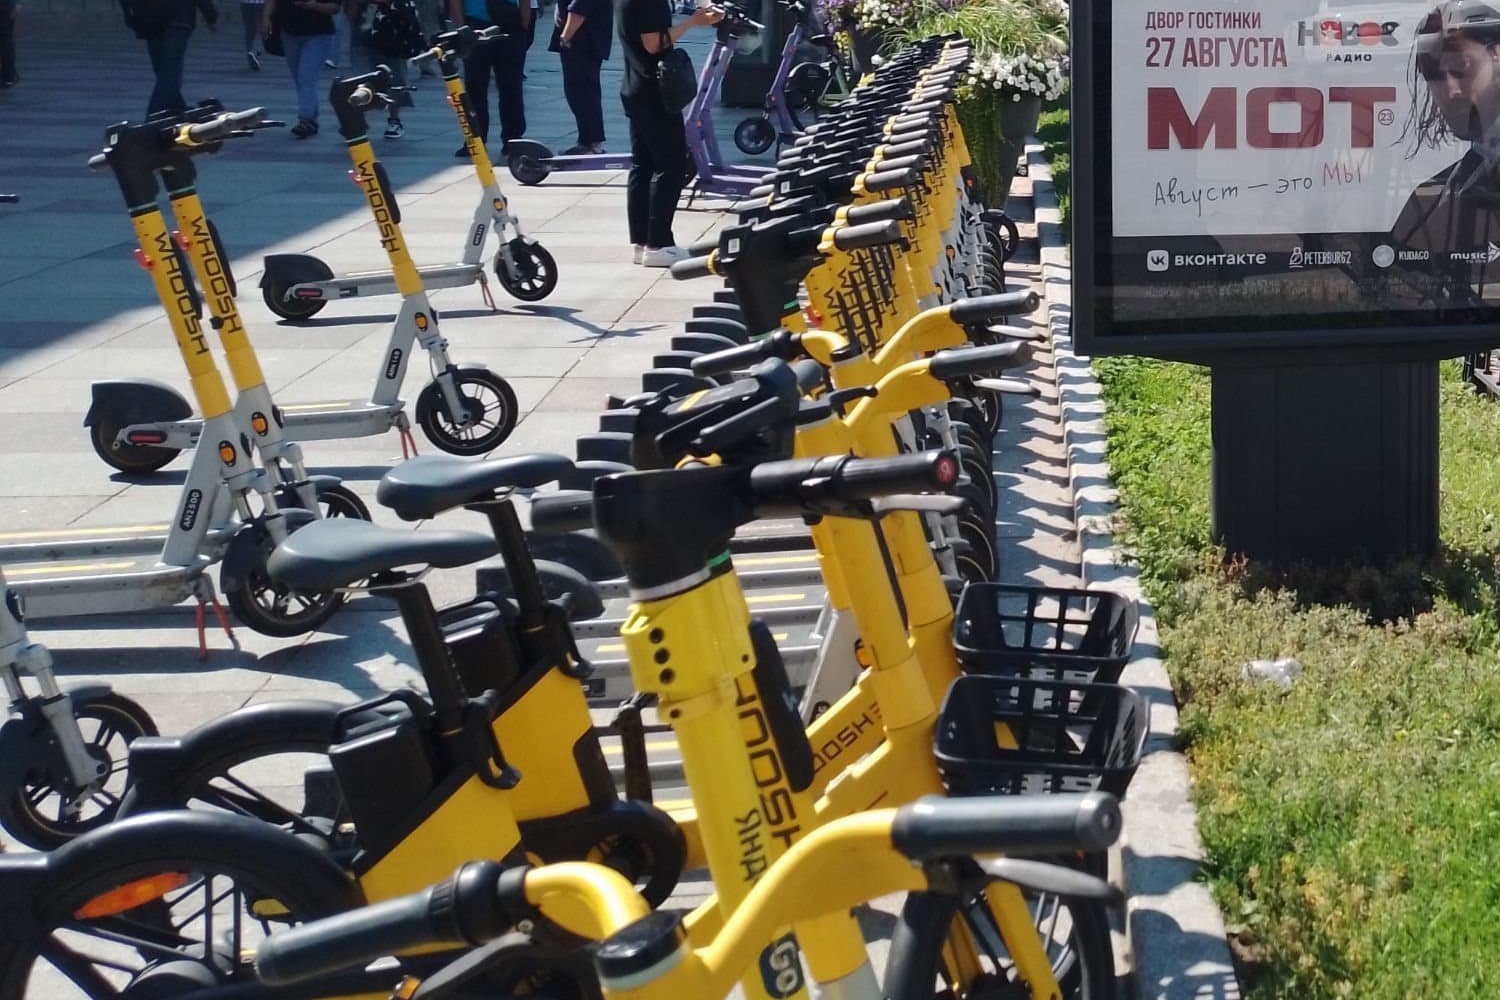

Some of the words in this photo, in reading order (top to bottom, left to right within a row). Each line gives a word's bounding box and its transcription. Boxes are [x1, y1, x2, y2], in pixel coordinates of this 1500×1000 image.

[1145, 11, 1184, 30] ДВОР
[1188, 11, 1261, 29] ГОСТИНКИ
[1145, 37, 1176, 67] 27
[1182, 37, 1288, 67] АВГУСТА
[1147, 87, 1396, 149] МОТ
[358, 160, 400, 253] WHOOSH
[1154, 177, 1238, 216] Август
[154, 231, 210, 355] WHOOSH
[192, 216, 243, 334] WHOOSH
